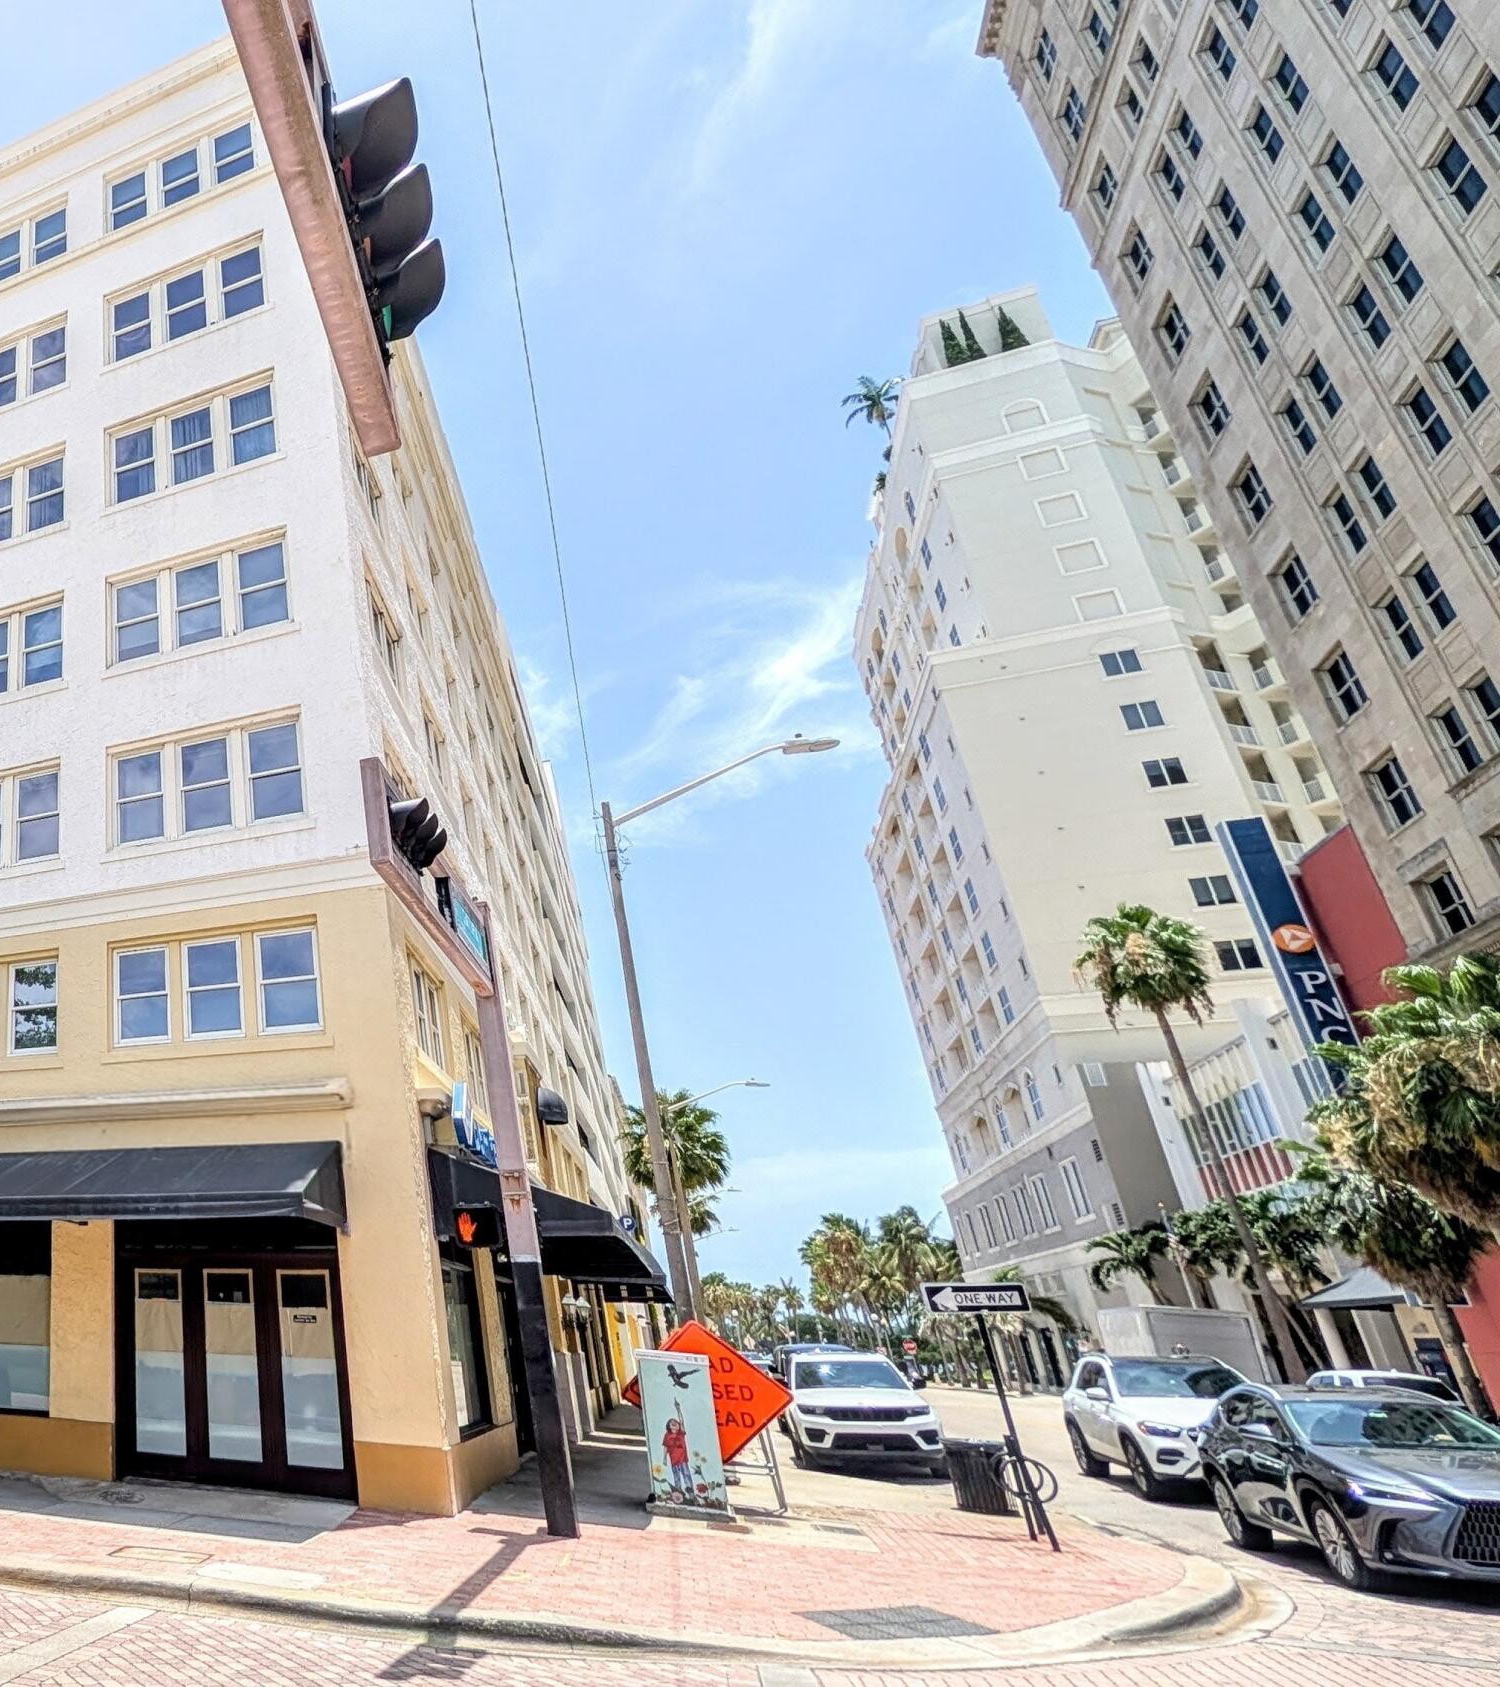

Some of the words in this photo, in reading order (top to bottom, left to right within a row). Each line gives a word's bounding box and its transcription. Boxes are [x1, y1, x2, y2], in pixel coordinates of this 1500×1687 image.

[1293, 970, 1348, 1043] PNC
[622, 1217, 633, 1229] P
[954, 1293, 983, 1304] ONE
[985, 1293, 1015, 1304] WAY
[716, 1410, 756, 1429] EAD
